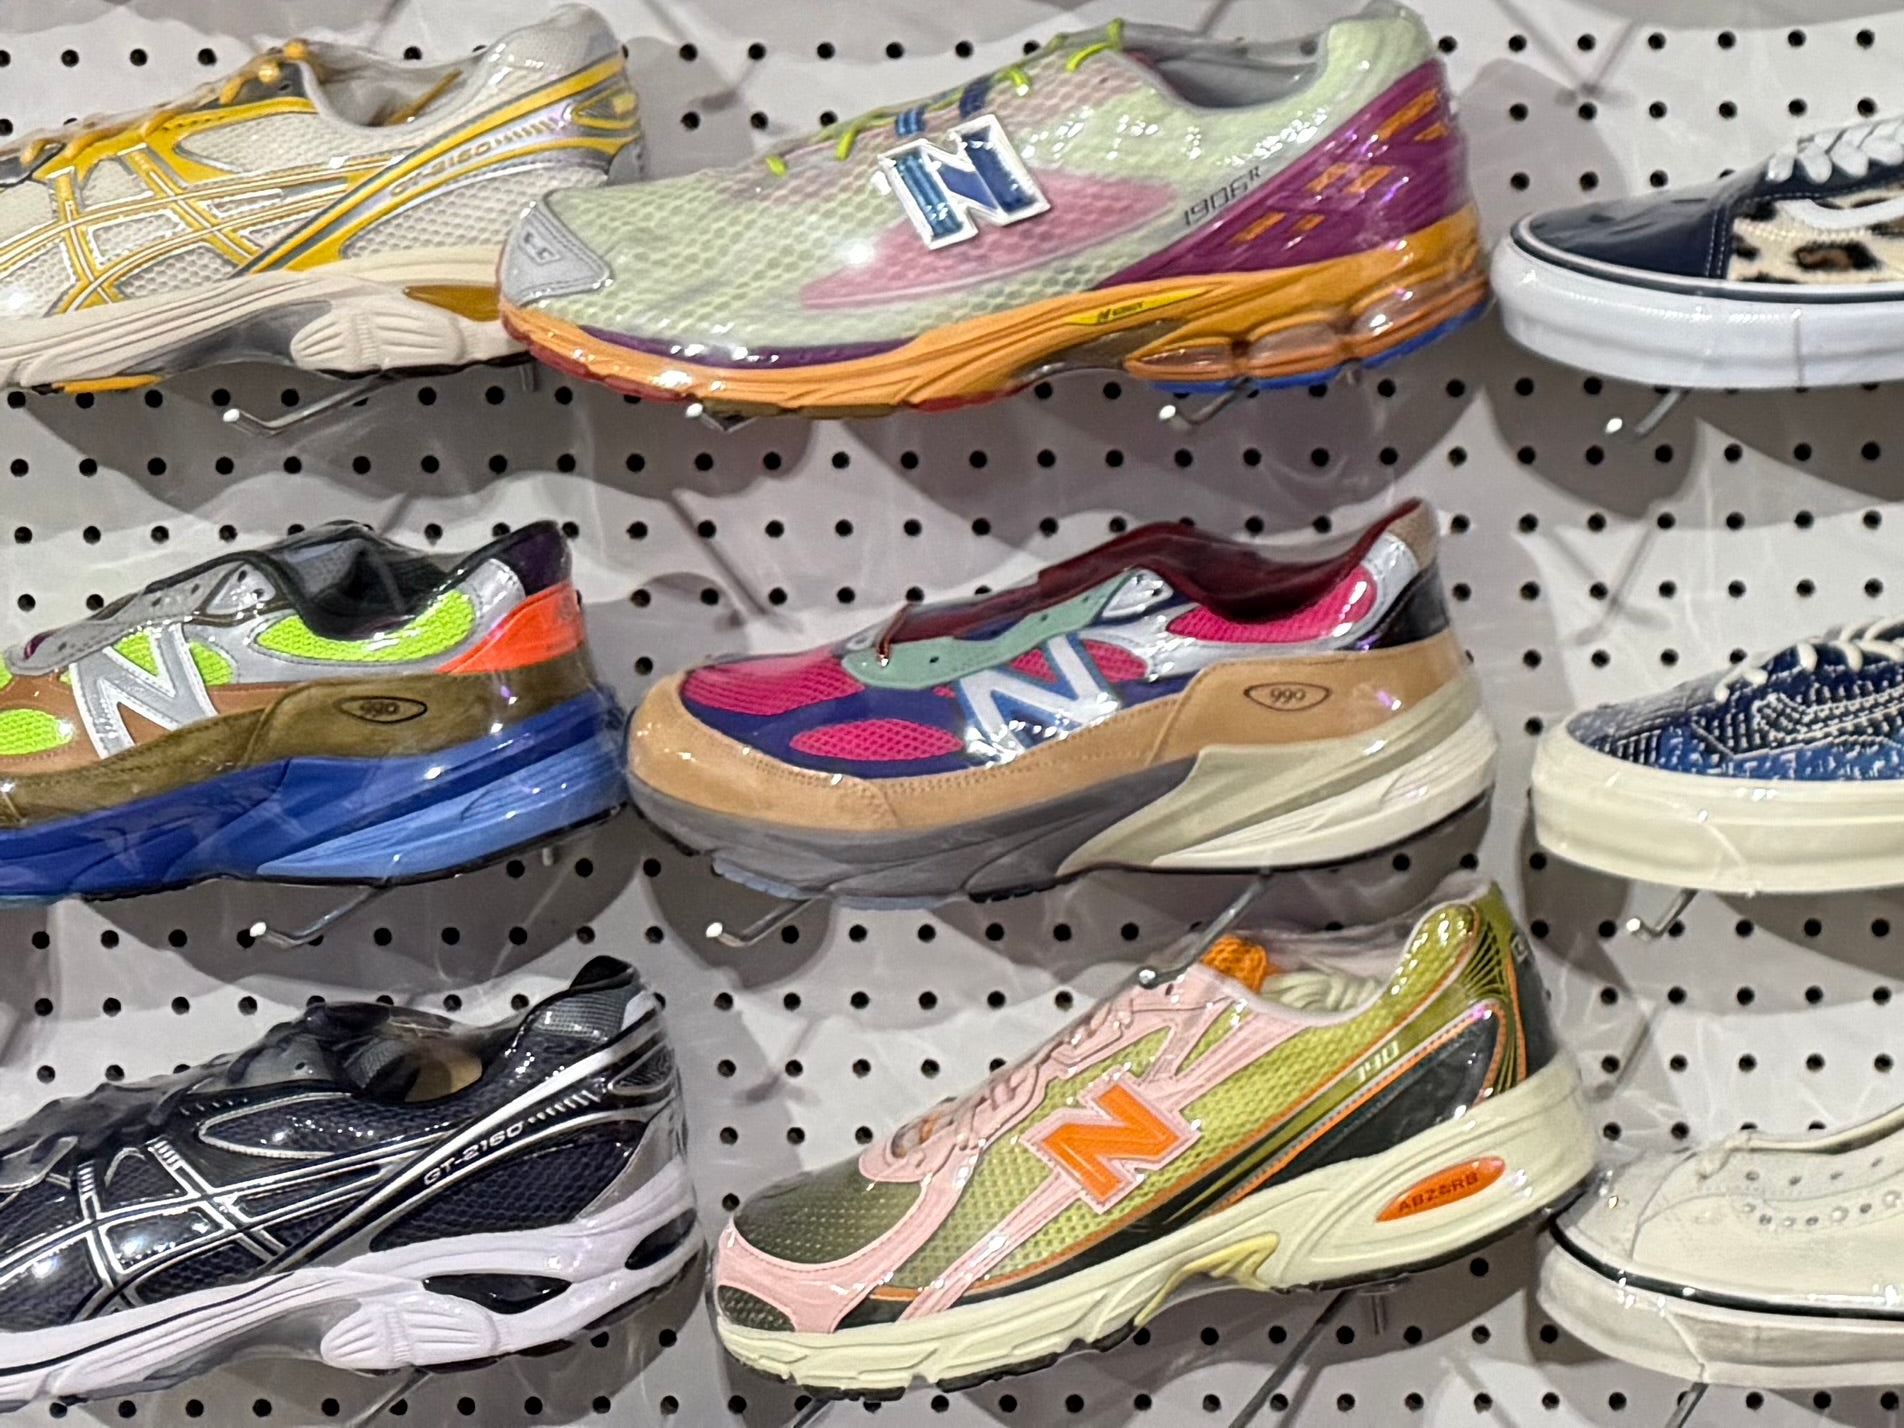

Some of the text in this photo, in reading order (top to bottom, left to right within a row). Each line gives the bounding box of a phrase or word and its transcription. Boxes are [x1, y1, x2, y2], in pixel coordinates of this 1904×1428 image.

[878, 113, 1051, 251] N
[423, 1119, 525, 1186] GT-2160
[1034, 1078, 1188, 1207] N
